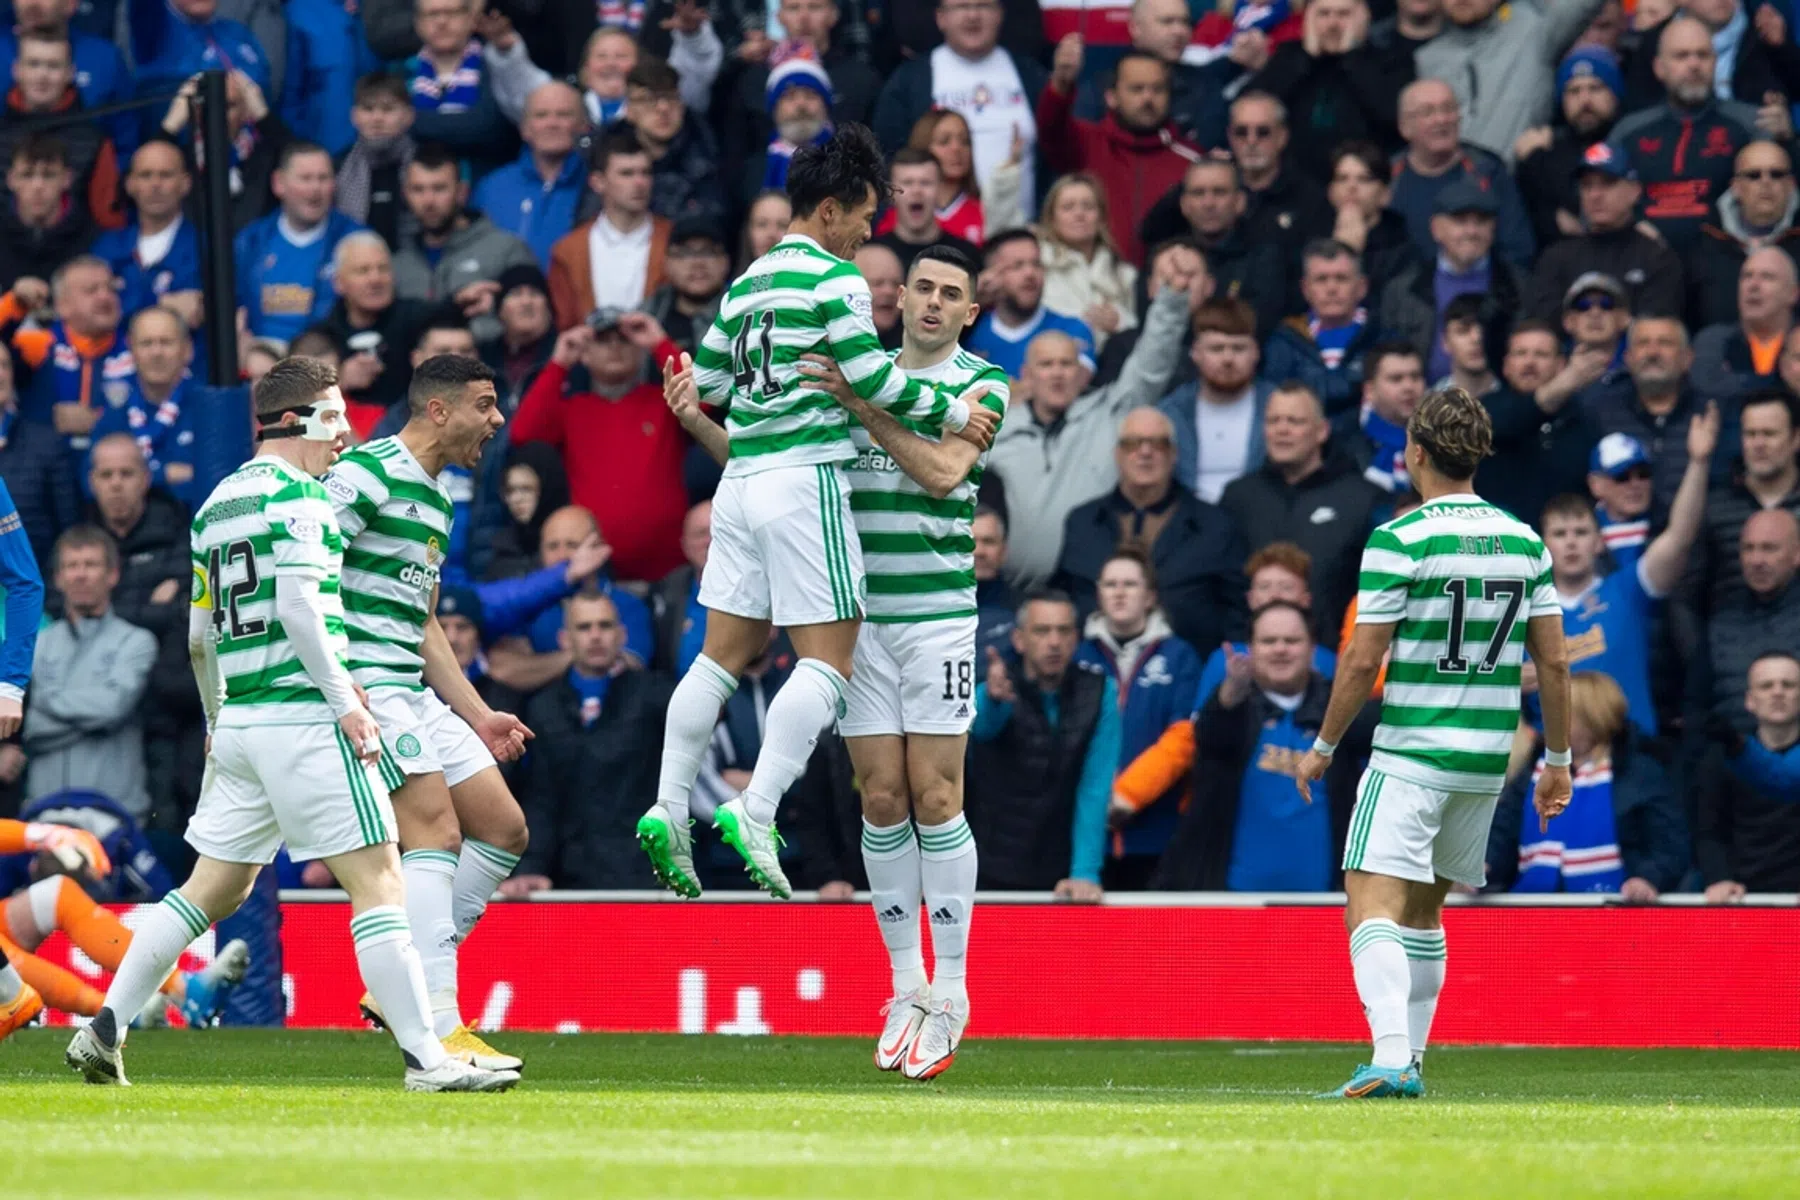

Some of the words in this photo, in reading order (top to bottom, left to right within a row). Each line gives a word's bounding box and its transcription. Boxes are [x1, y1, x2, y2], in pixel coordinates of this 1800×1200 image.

[734, 309, 784, 400] 41
[1420, 505, 1504, 520] MAGNER
[1457, 535, 1505, 555] JOTA
[209, 538, 268, 643] 42
[1437, 578, 1526, 674] 17
[942, 660, 971, 700] 18
